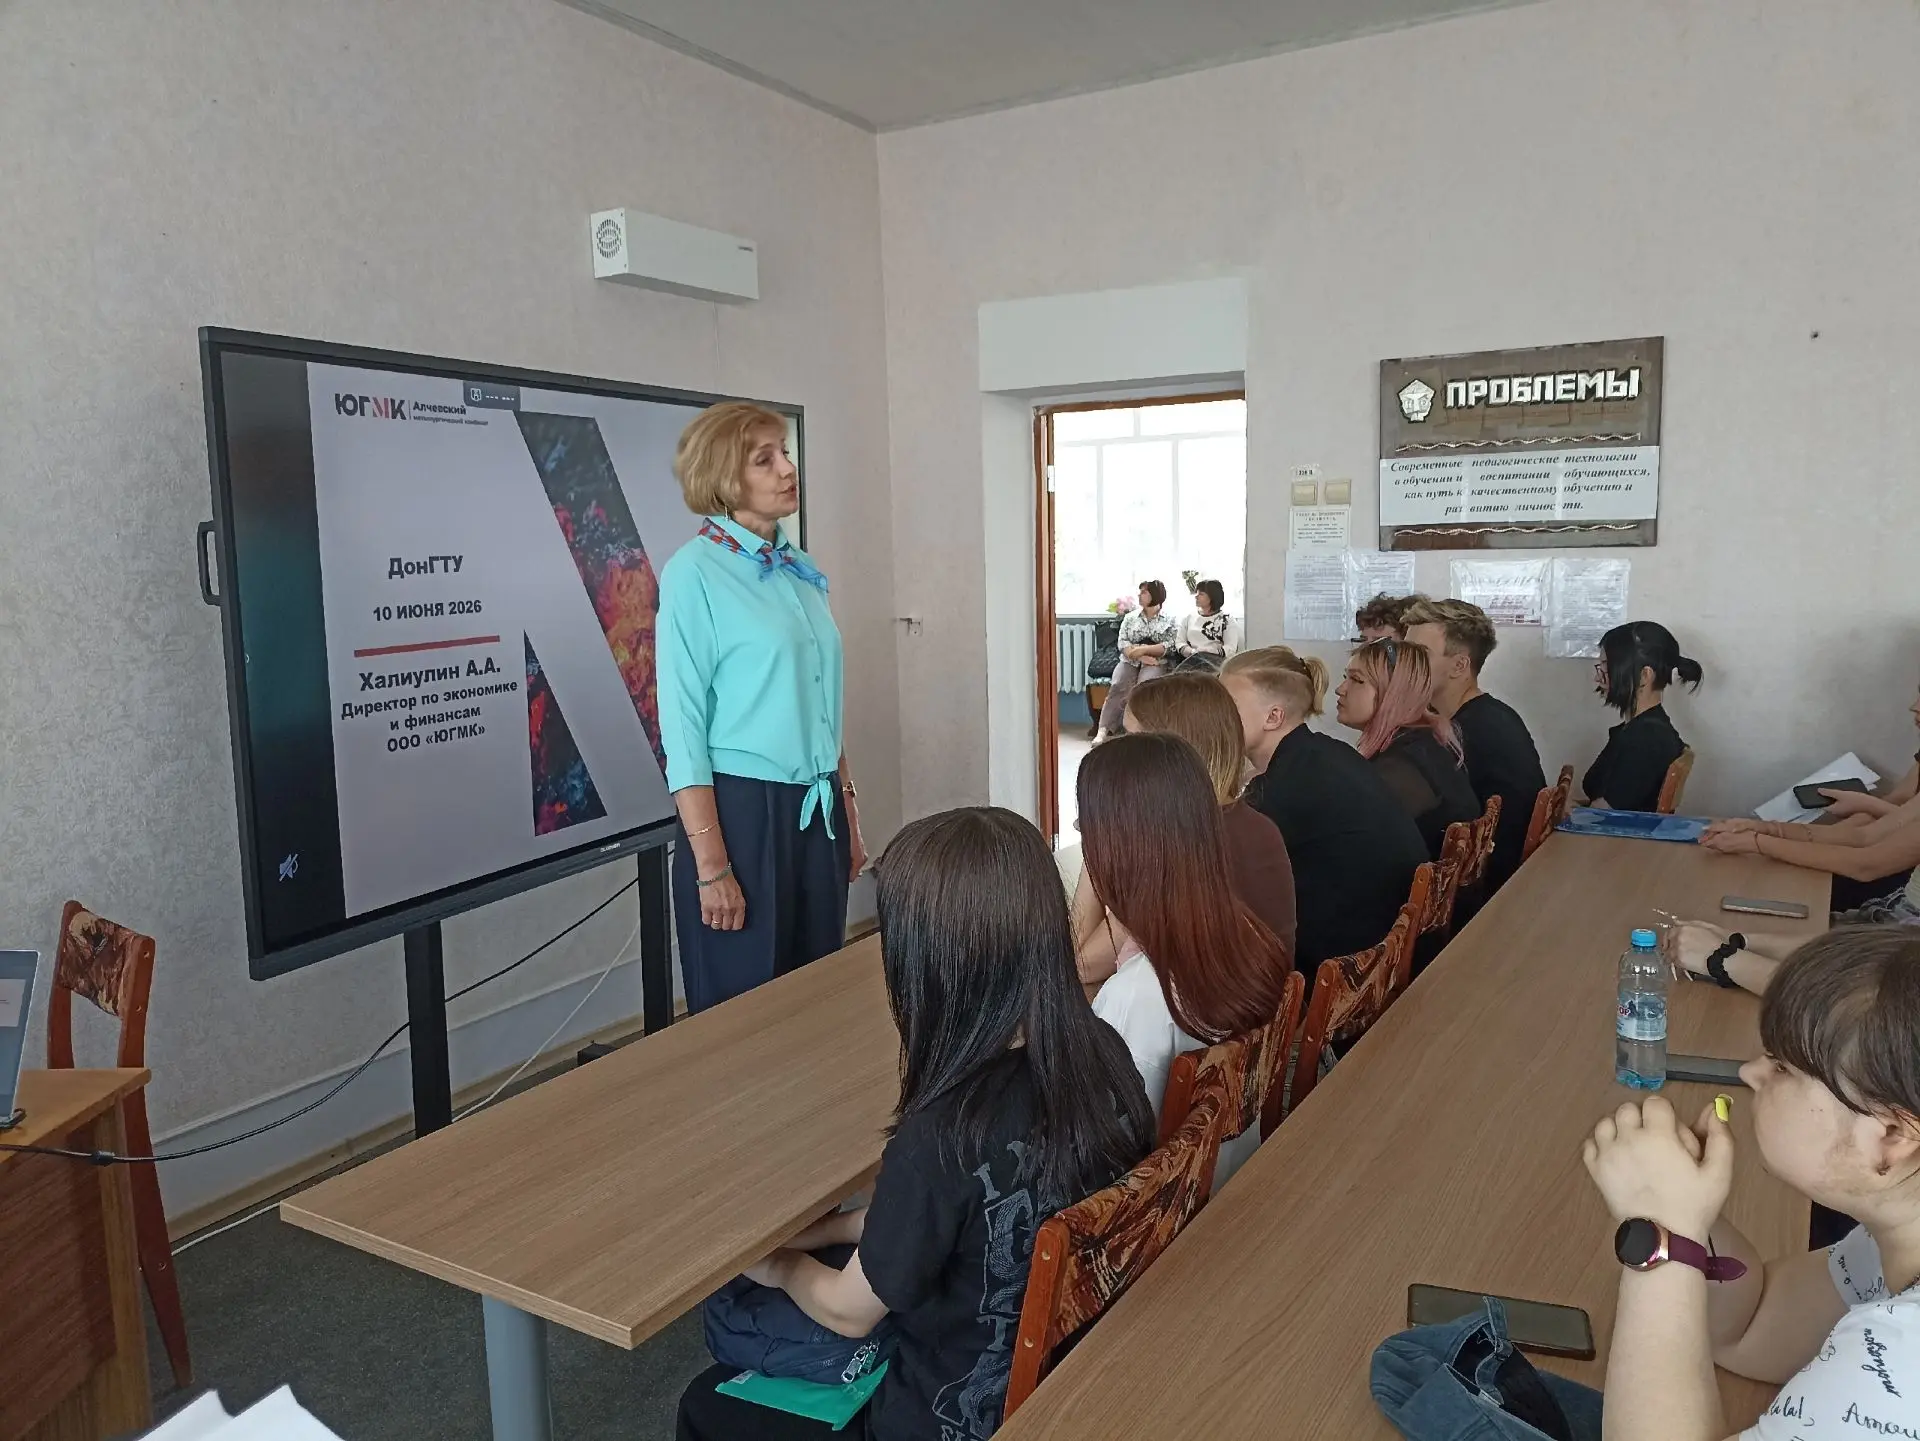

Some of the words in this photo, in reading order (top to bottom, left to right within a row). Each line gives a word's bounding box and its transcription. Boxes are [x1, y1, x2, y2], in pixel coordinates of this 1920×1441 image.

[1446, 366, 1642, 409] ПРОБЛЕМЫ
[334, 393, 407, 420] ЮГМК
[413, 400, 466, 415] Алчевский
[1391, 460, 1463, 473] Современные
[1472, 456, 1559, 467] педагогические
[1564, 453, 1637, 463] технологии
[1403, 476, 1453, 486] обучении
[1480, 472, 1550, 482] воспитании
[1564, 468, 1651, 480] обучающихся,
[1426, 489, 1453, 500] путь
[1471, 486, 1557, 496] качественному
[1563, 483, 1621, 494] обучению
[388, 555, 463, 579] ДонГТУ
[373, 606, 392, 621] 10
[396, 602, 444, 619] ИЮНЯ
[448, 600, 482, 615] 2026
[359, 665, 460, 691] Халиулин
[466, 656, 501, 676] А.А.
[341, 696, 417, 720] Директор
[421, 692, 439, 706] по
[443, 681, 517, 702] экономике
[390, 720, 399, 731] и
[404, 705, 481, 731] финансам
[387, 734, 421, 752] ООО
[426, 723, 485, 745] «ЮГМК»
